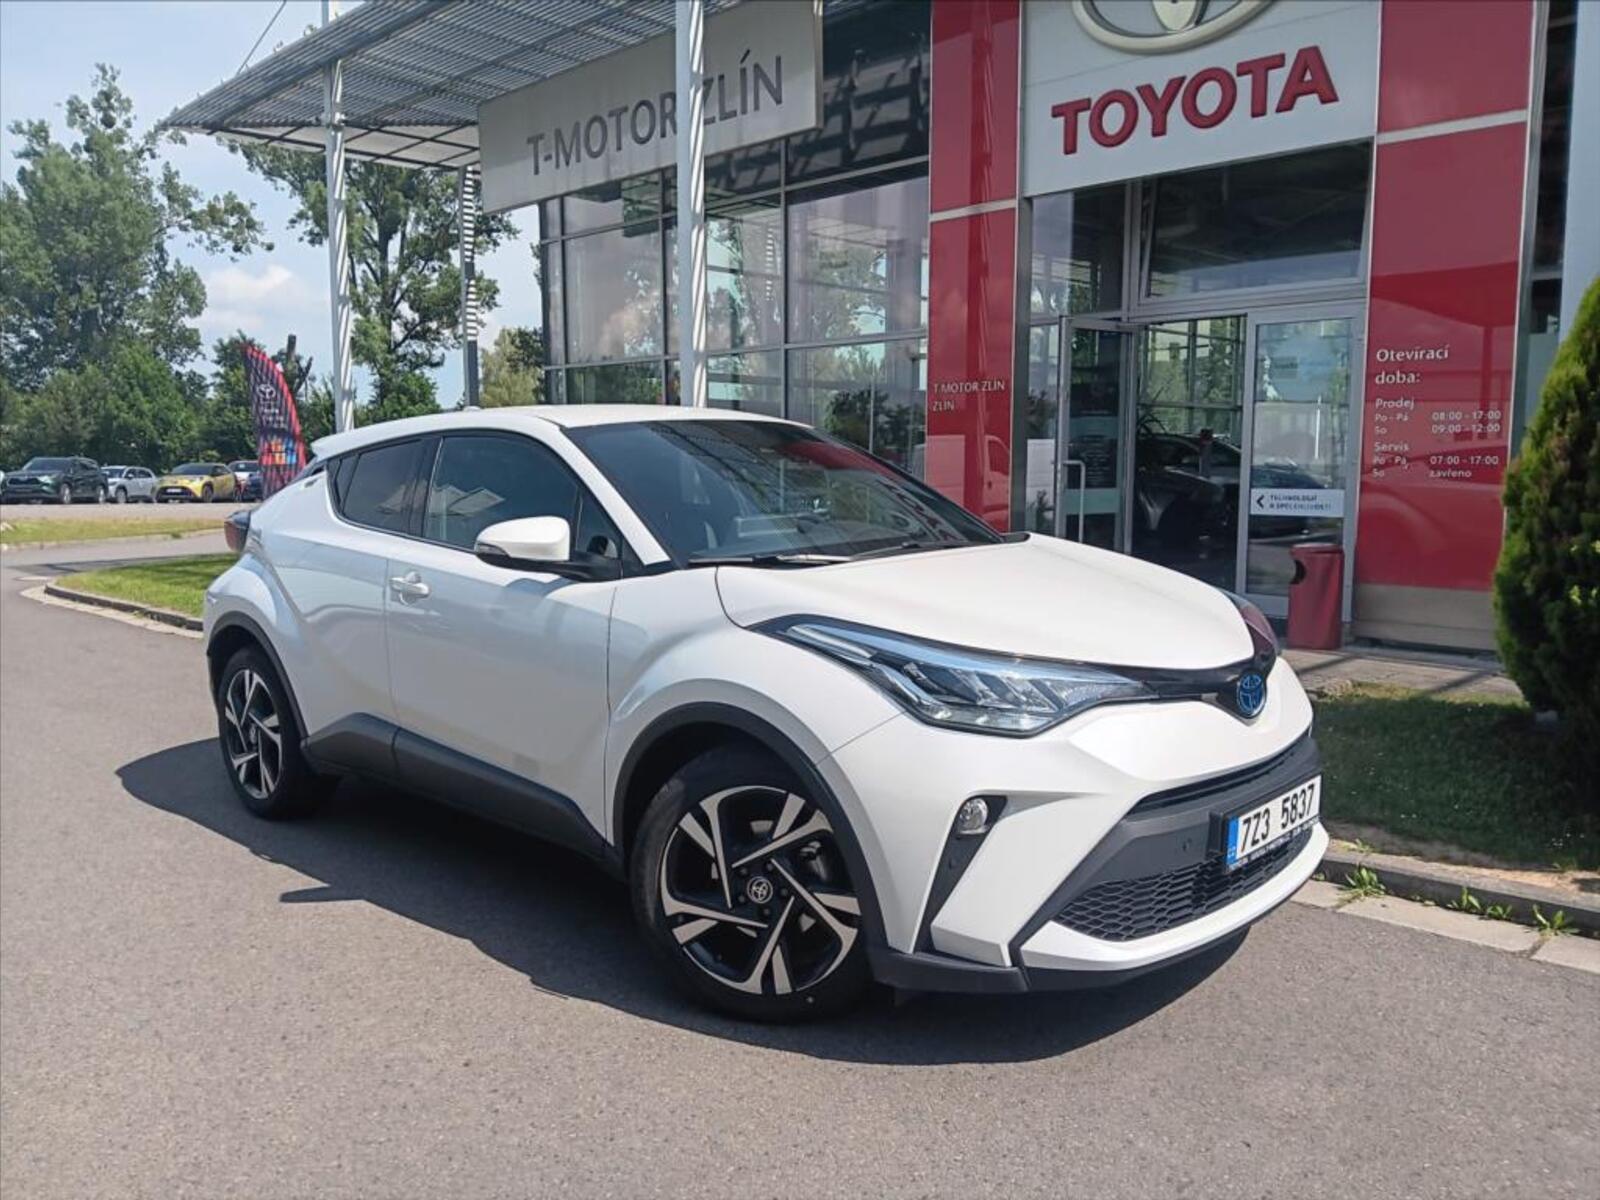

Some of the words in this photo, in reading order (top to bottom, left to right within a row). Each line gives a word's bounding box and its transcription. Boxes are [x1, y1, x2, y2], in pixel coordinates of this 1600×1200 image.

[1051, 46, 1339, 155] TOYOTA
[527, 91, 677, 175] T-MOTOR
[1376, 344, 1449, 362] Otevírací
[1375, 370, 1420, 384] doba:
[941, 381, 979, 394] MOTOR
[1375, 397, 1414, 411] Prodej
[1375, 413, 1388, 421] Po
[1431, 411, 1462, 421] 08:00
[1472, 410, 1501, 420] 17:00
[1375, 426, 1387, 434] So
[1431, 424, 1461, 434] 09:00
[1472, 423, 1500, 433] 12:00
[1374, 442, 1409, 452] Servis
[1430, 456, 1460, 465] 07:00
[1470, 456, 1499, 465] 17:00
[1241, 807, 1270, 852] 7Z3
[1281, 783, 1315, 829] 5837
